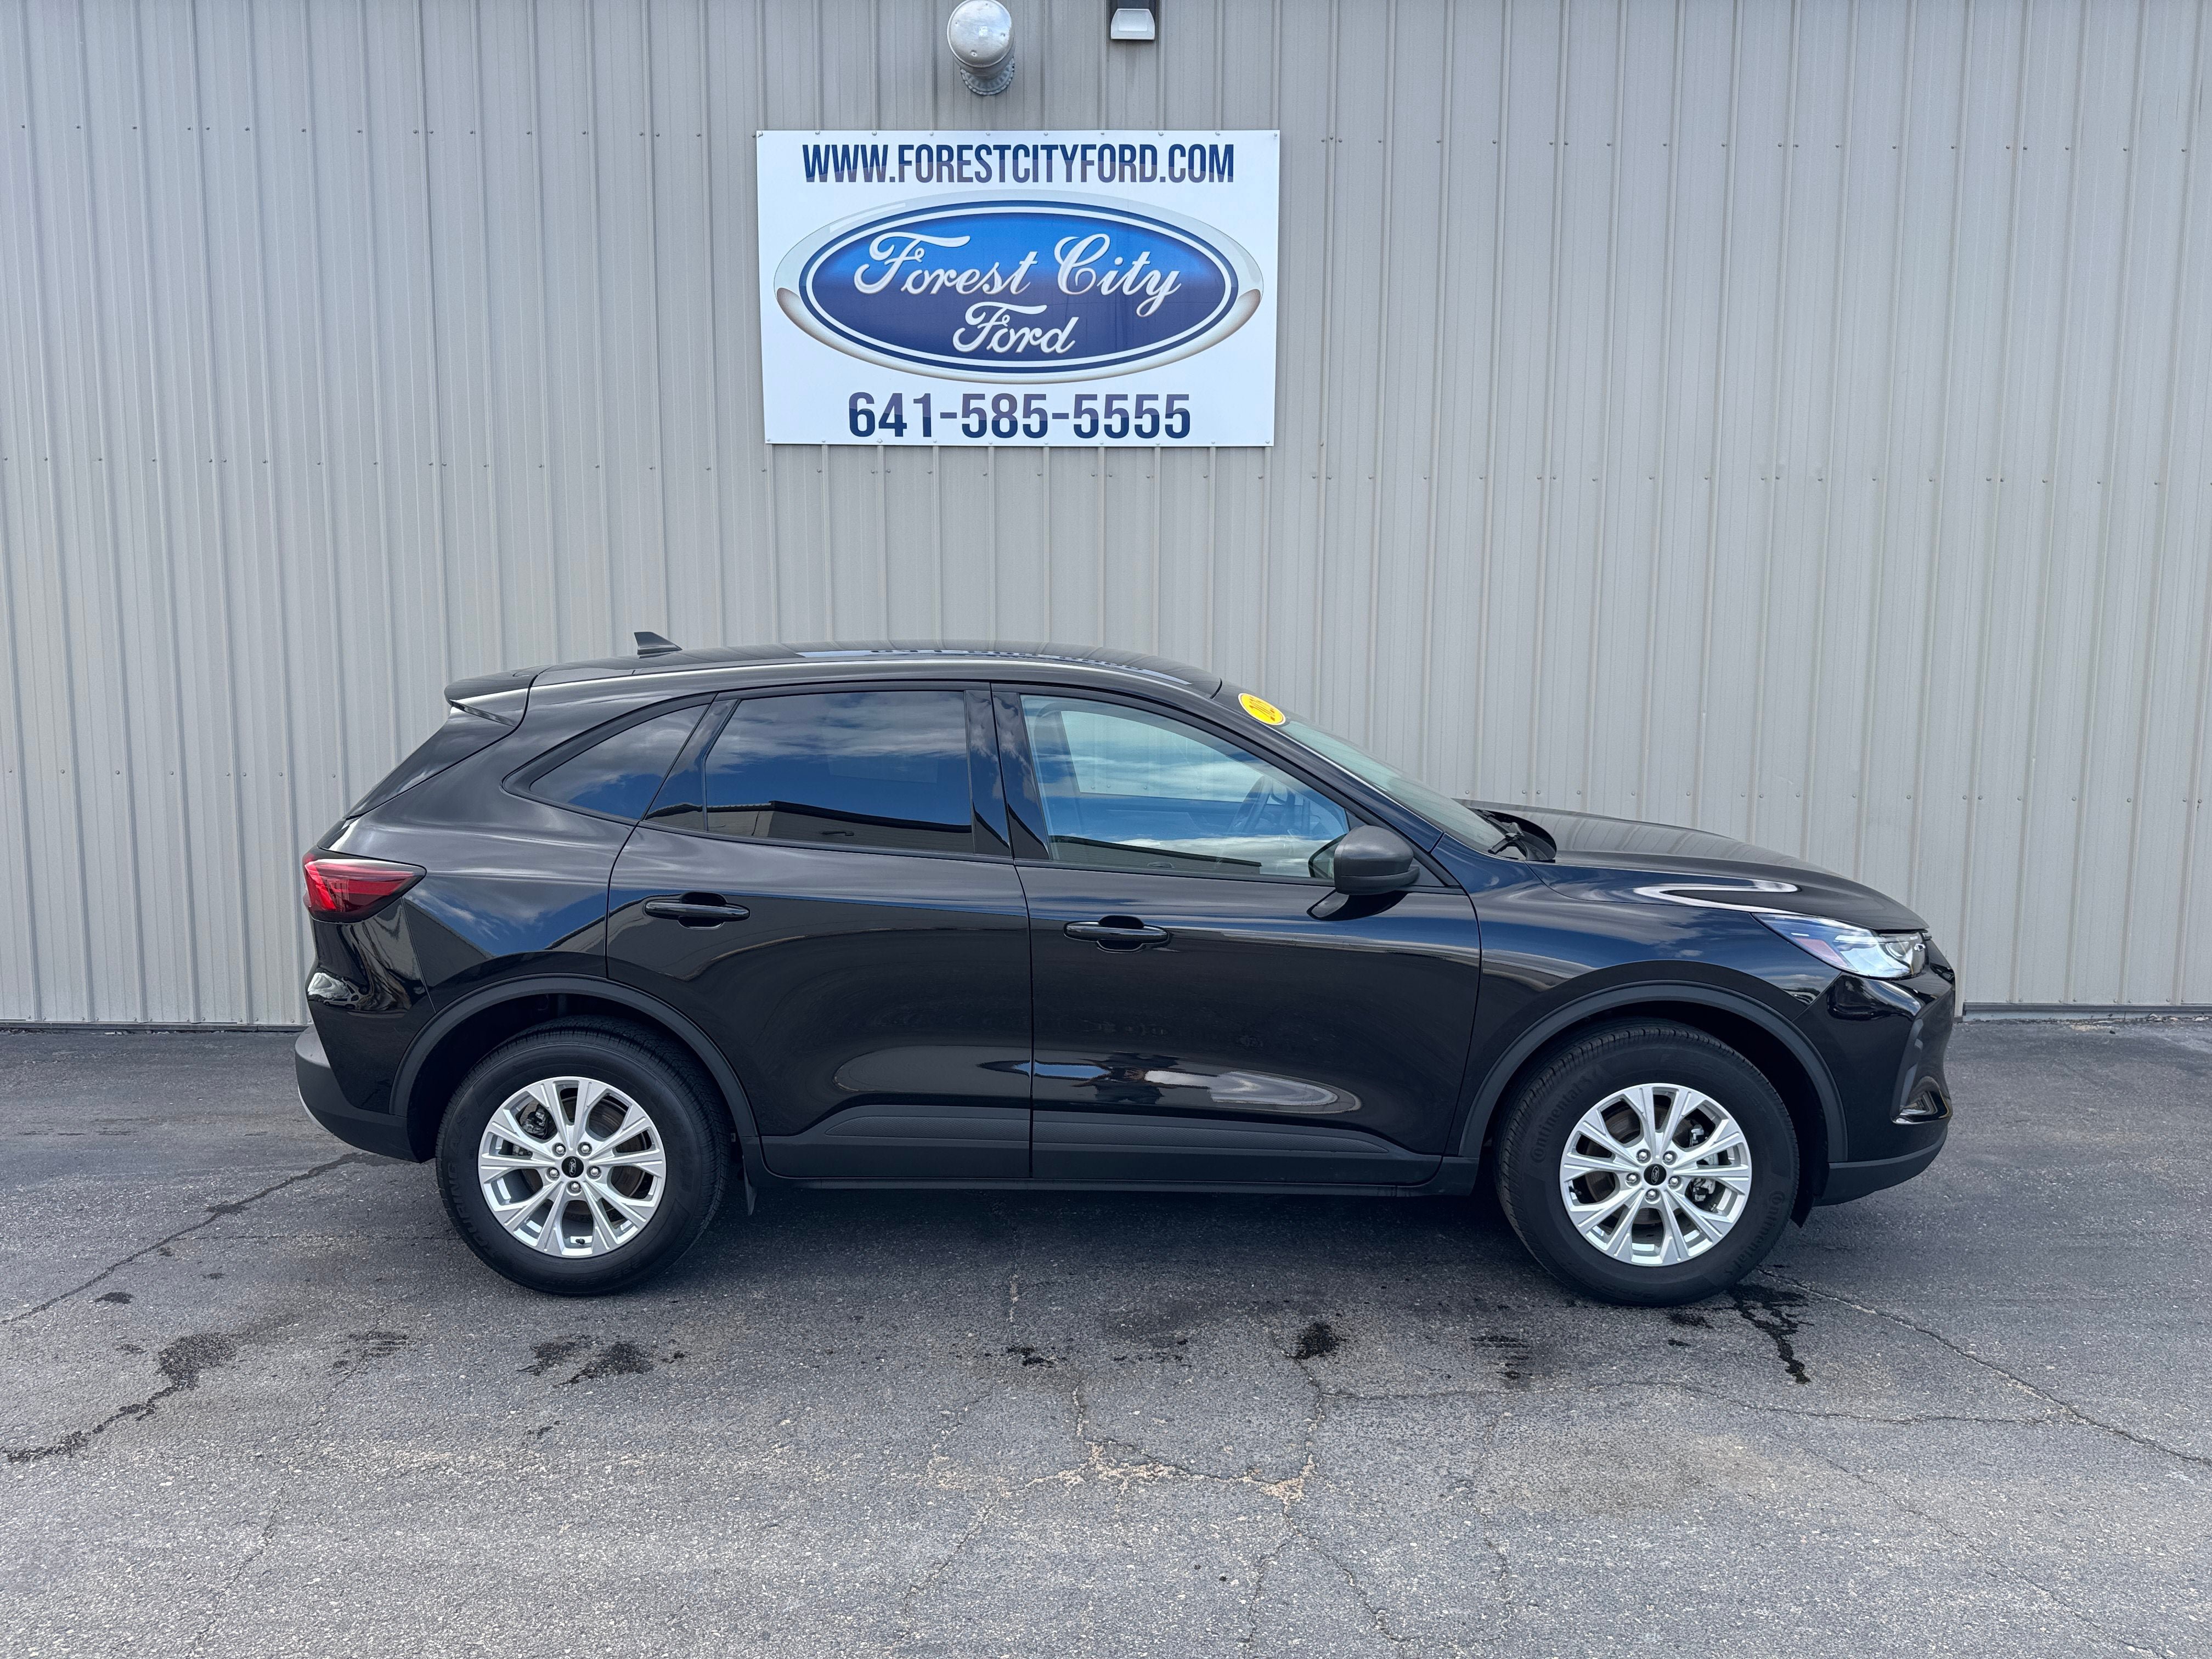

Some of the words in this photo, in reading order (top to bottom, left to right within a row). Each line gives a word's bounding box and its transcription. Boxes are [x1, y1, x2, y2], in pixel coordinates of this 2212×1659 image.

[803, 144, 1233, 183] WWW.FORESTCITYFORD.COM
[853, 231, 1038, 295] Forest
[1053, 233, 1182, 318] City
[952, 301, 1081, 354] Ford
[849, 392, 1190, 438] 641-585-5555
